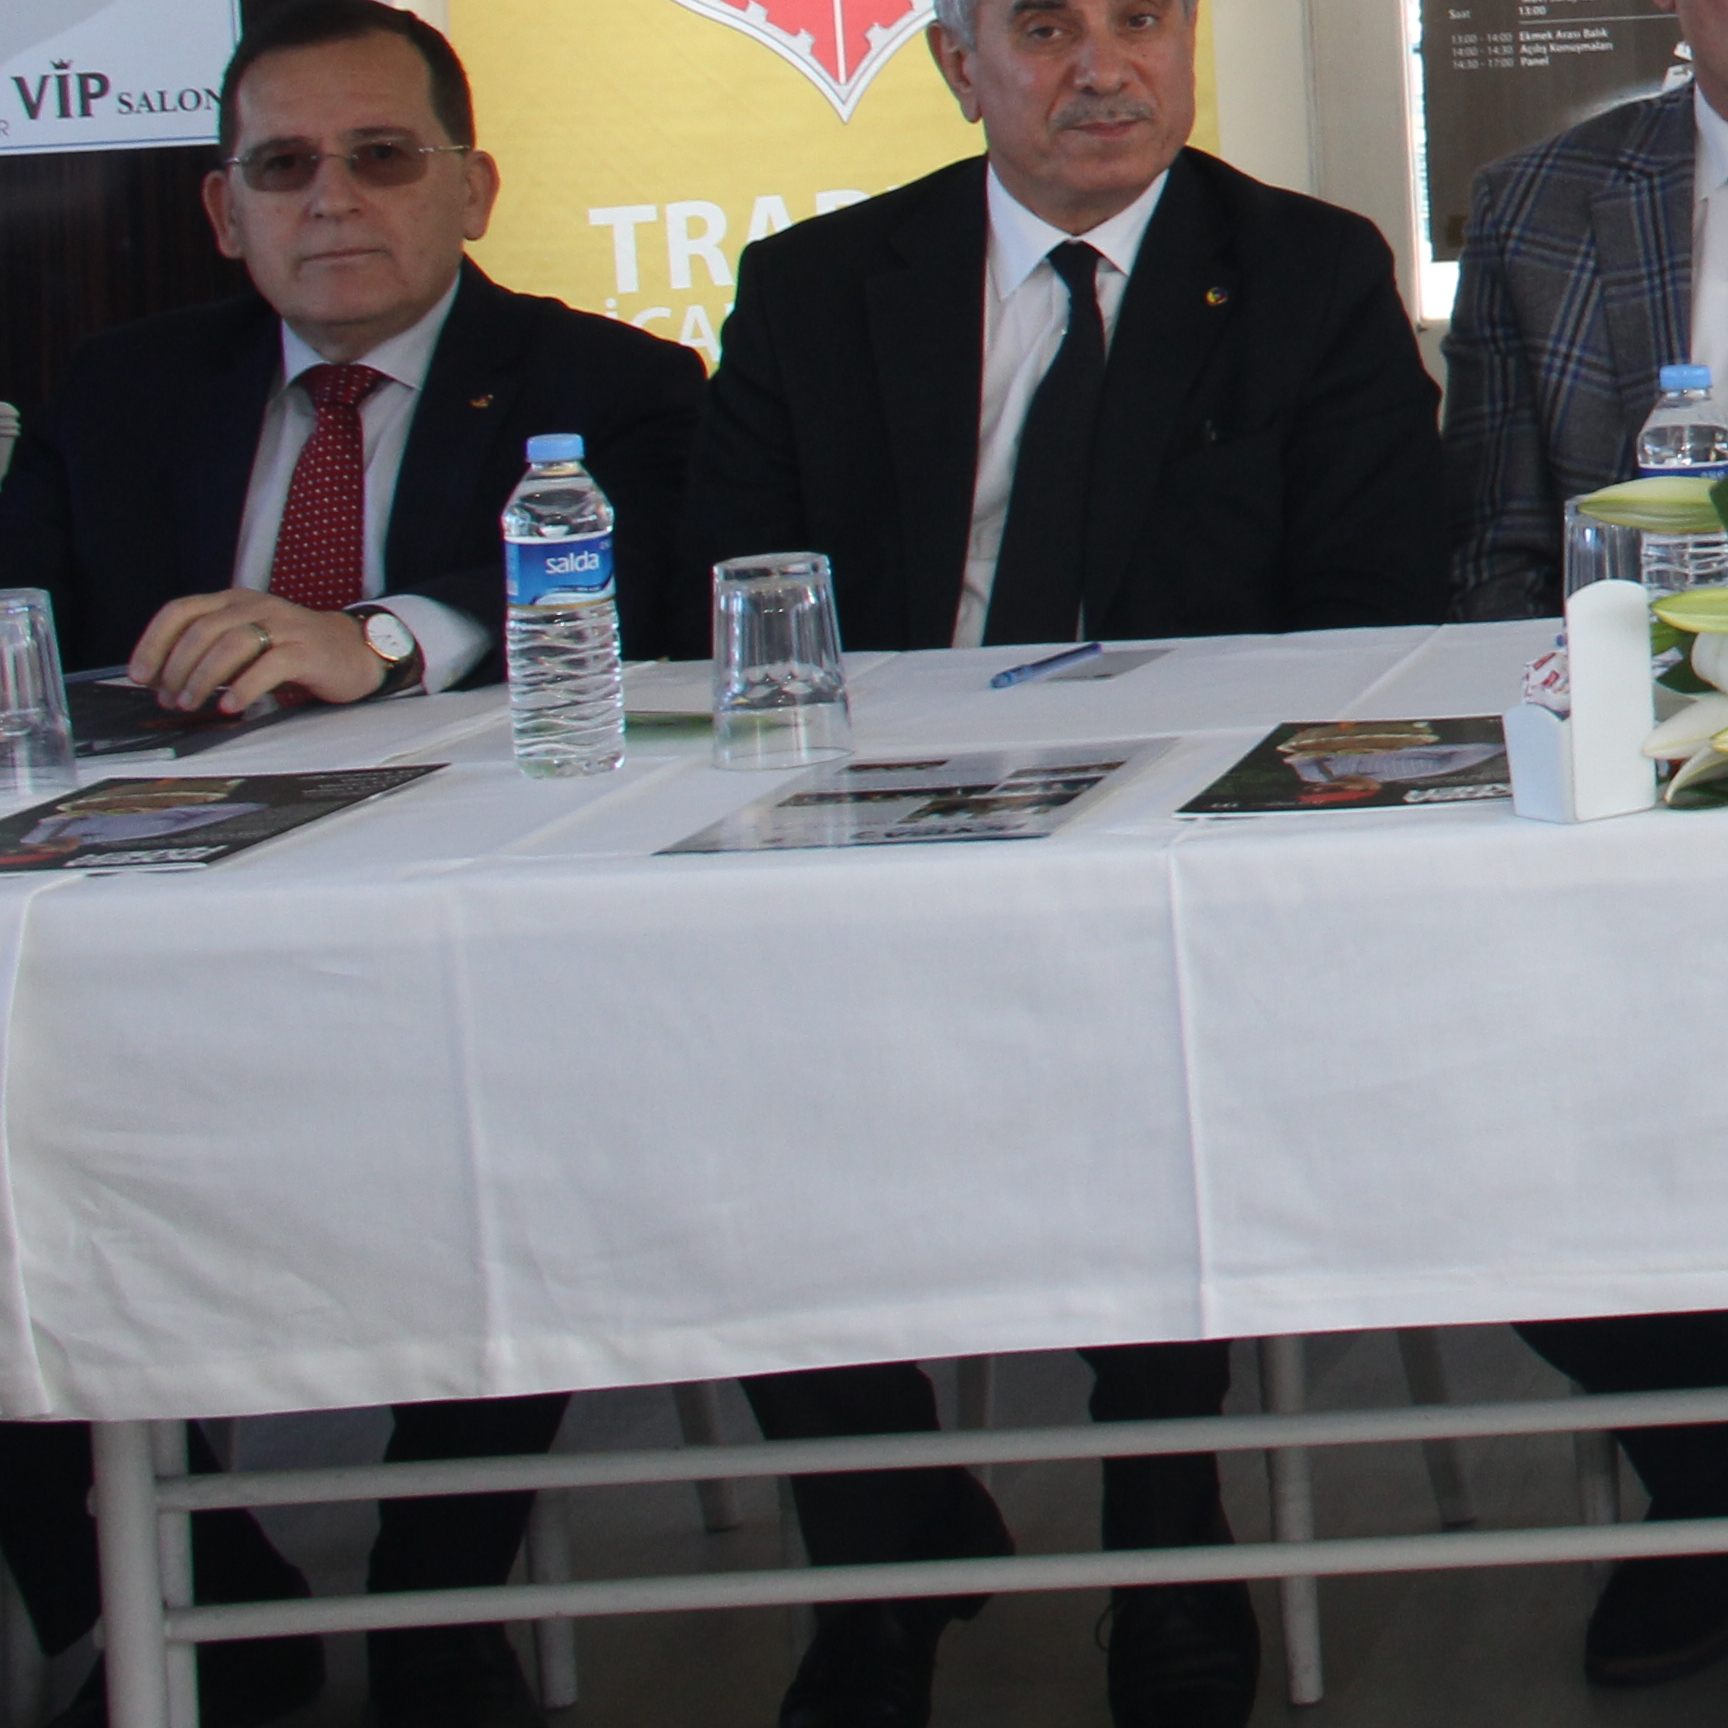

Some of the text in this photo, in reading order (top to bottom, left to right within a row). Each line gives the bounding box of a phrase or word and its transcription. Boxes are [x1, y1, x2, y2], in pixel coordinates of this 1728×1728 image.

[1518, 30, 1553, 42] Ekmek
[1520, 56, 1550, 67] Panel
[545, 550, 600, 574] salda
